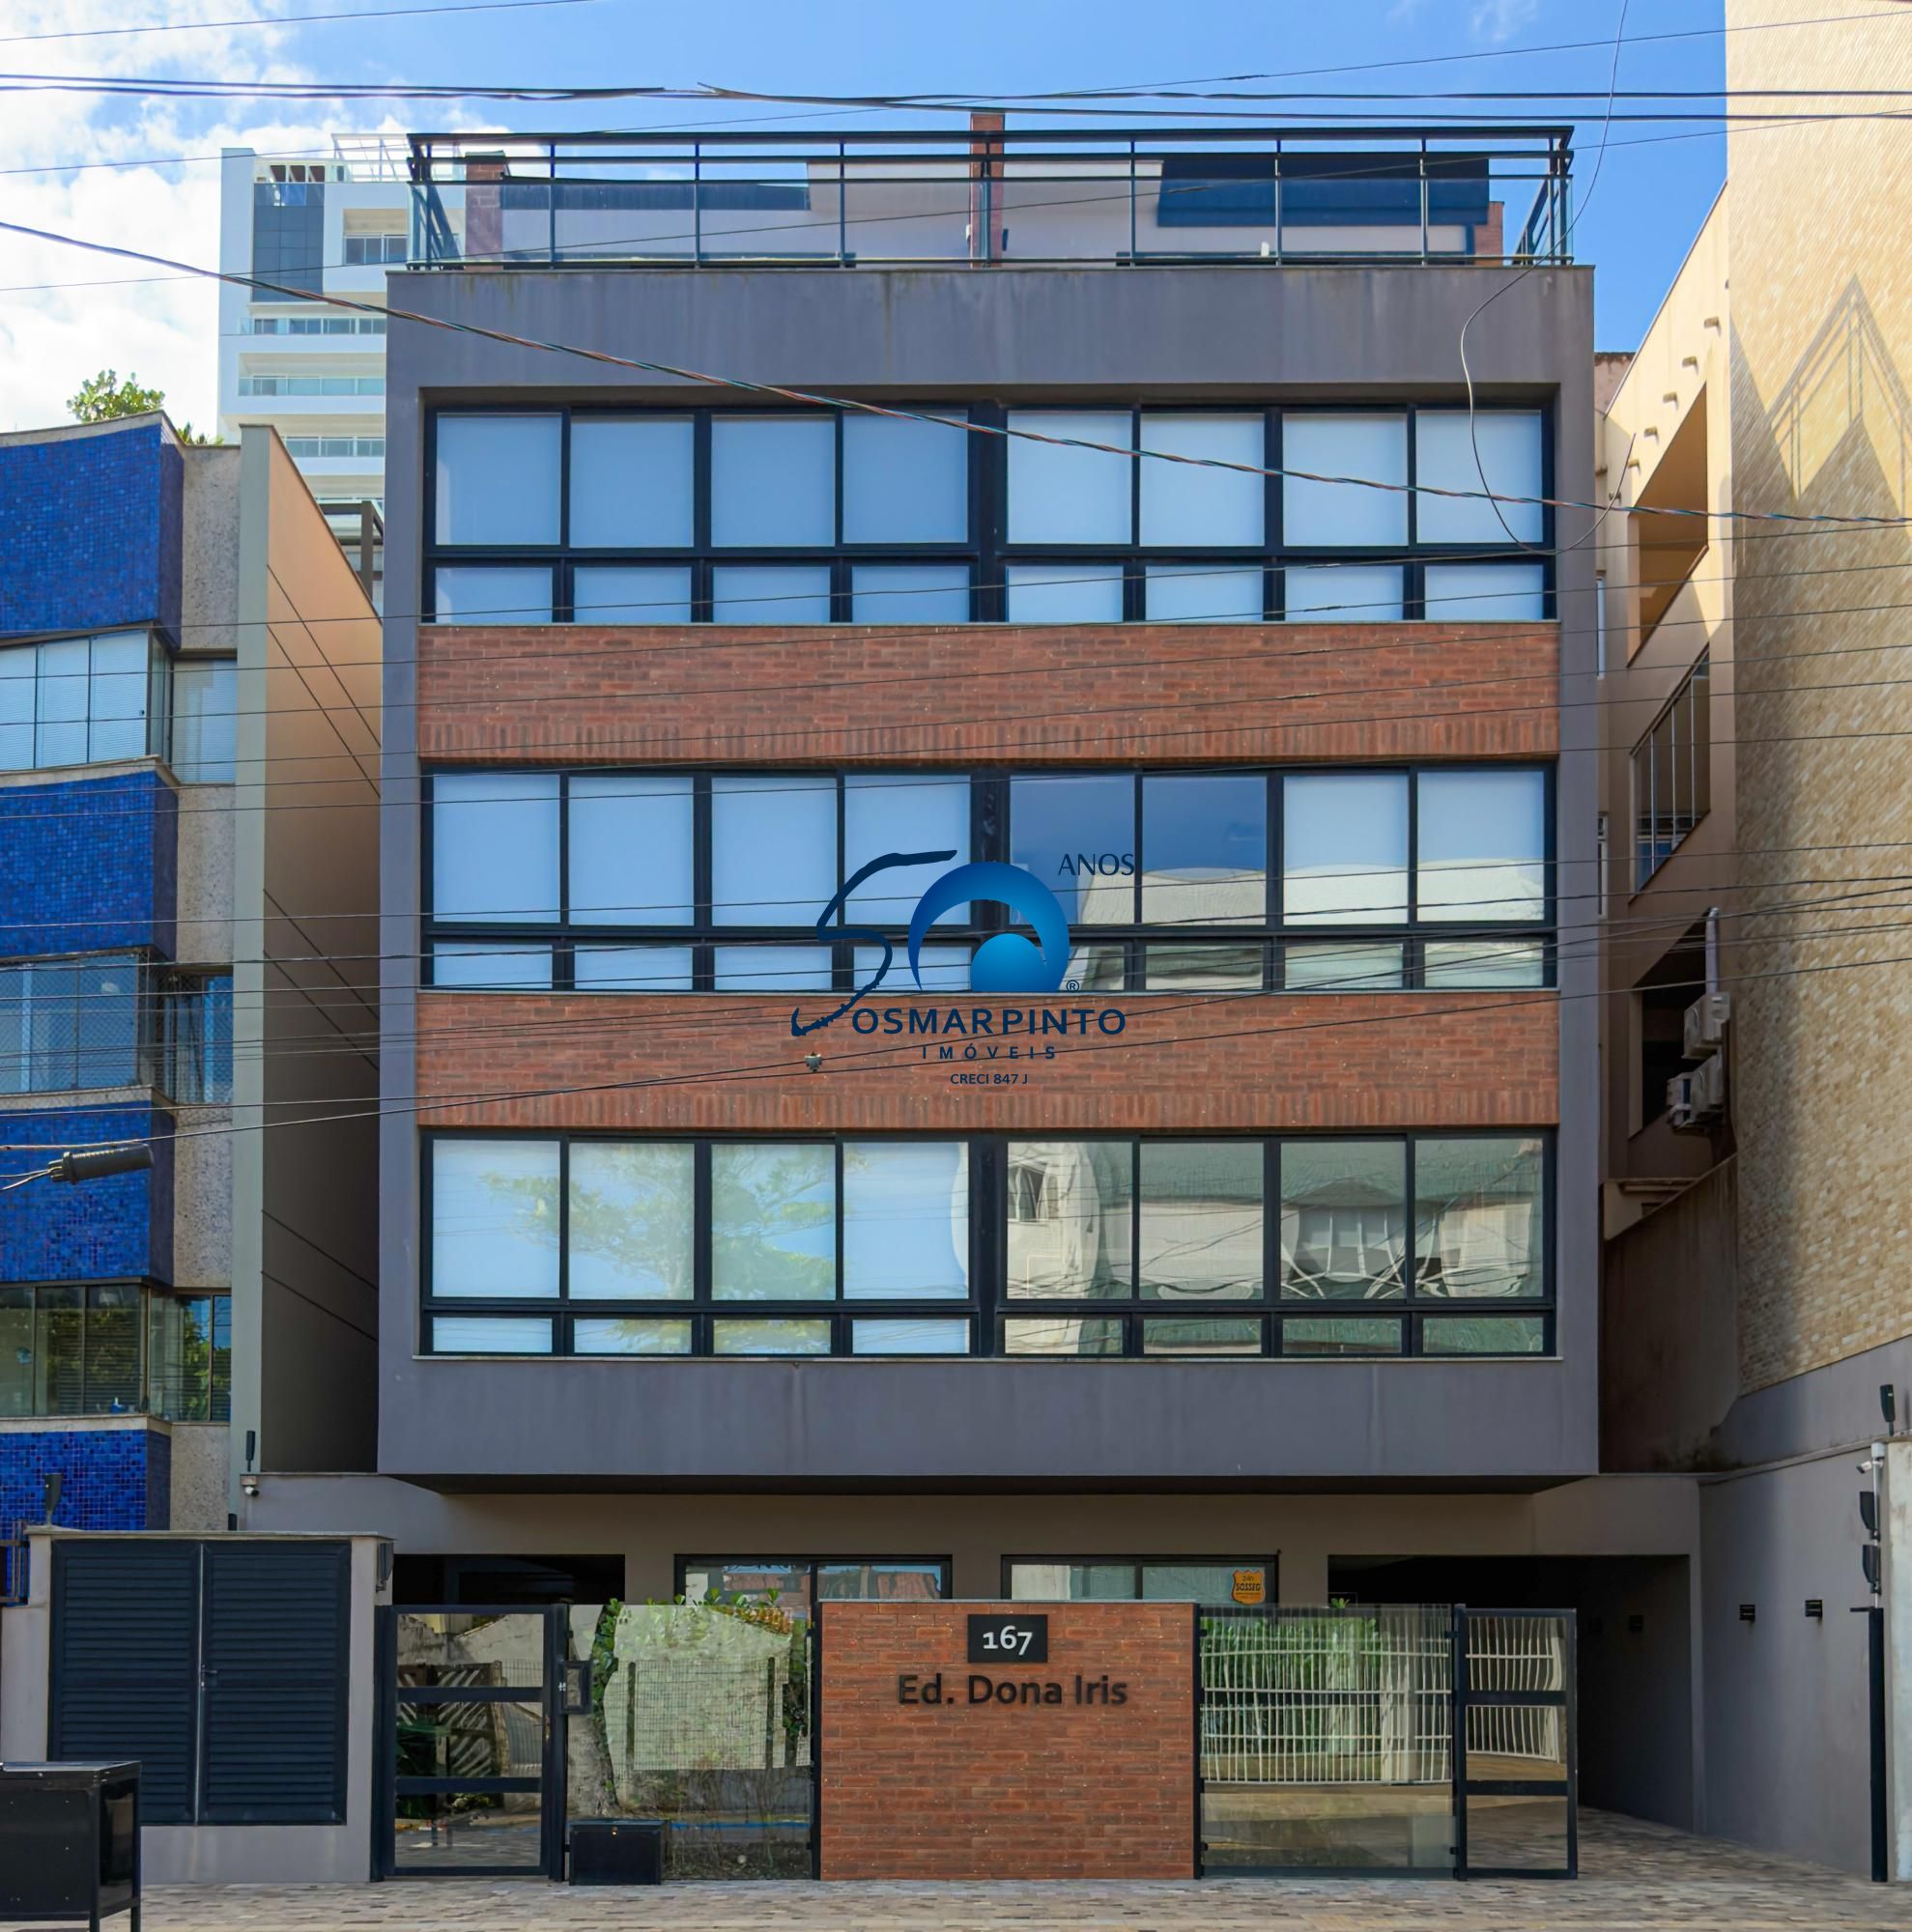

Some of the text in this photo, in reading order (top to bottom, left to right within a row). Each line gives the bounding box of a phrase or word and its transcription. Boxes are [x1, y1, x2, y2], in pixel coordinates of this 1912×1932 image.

[983, 1626, 1034, 1657] 167
[898, 1672, 1128, 1705] Ed. Dona Iris
